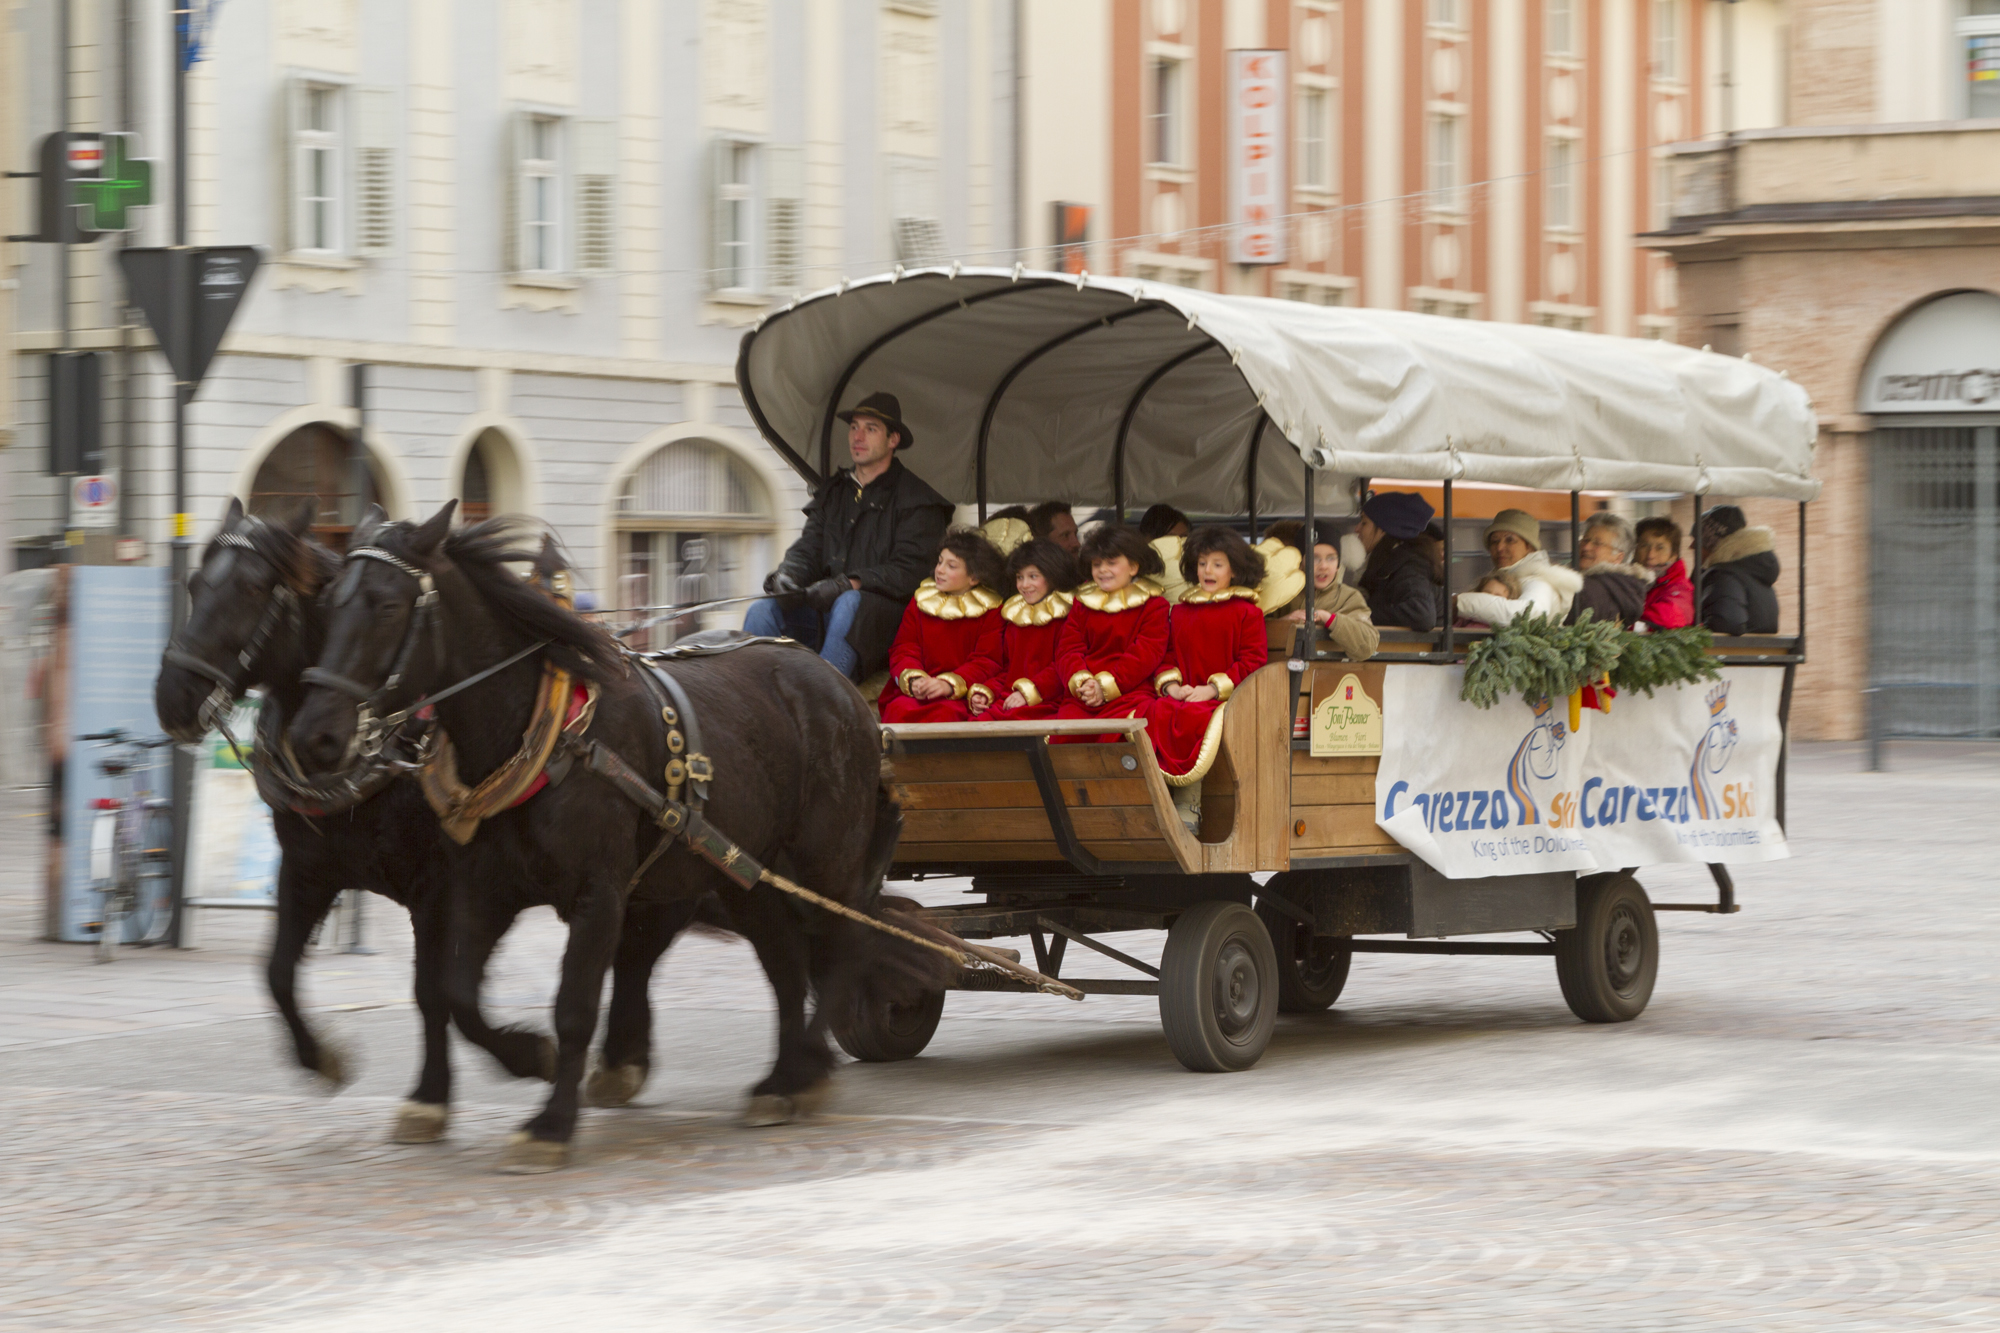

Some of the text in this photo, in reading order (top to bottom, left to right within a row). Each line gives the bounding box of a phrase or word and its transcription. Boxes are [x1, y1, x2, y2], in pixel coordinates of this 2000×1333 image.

[1325, 706, 1345, 730] Toni
[1580, 776, 1690, 829] Carezza
[1471, 838, 1498, 861] King
[1497, 837, 1510, 856] of
[1510, 836, 1530, 855] the
